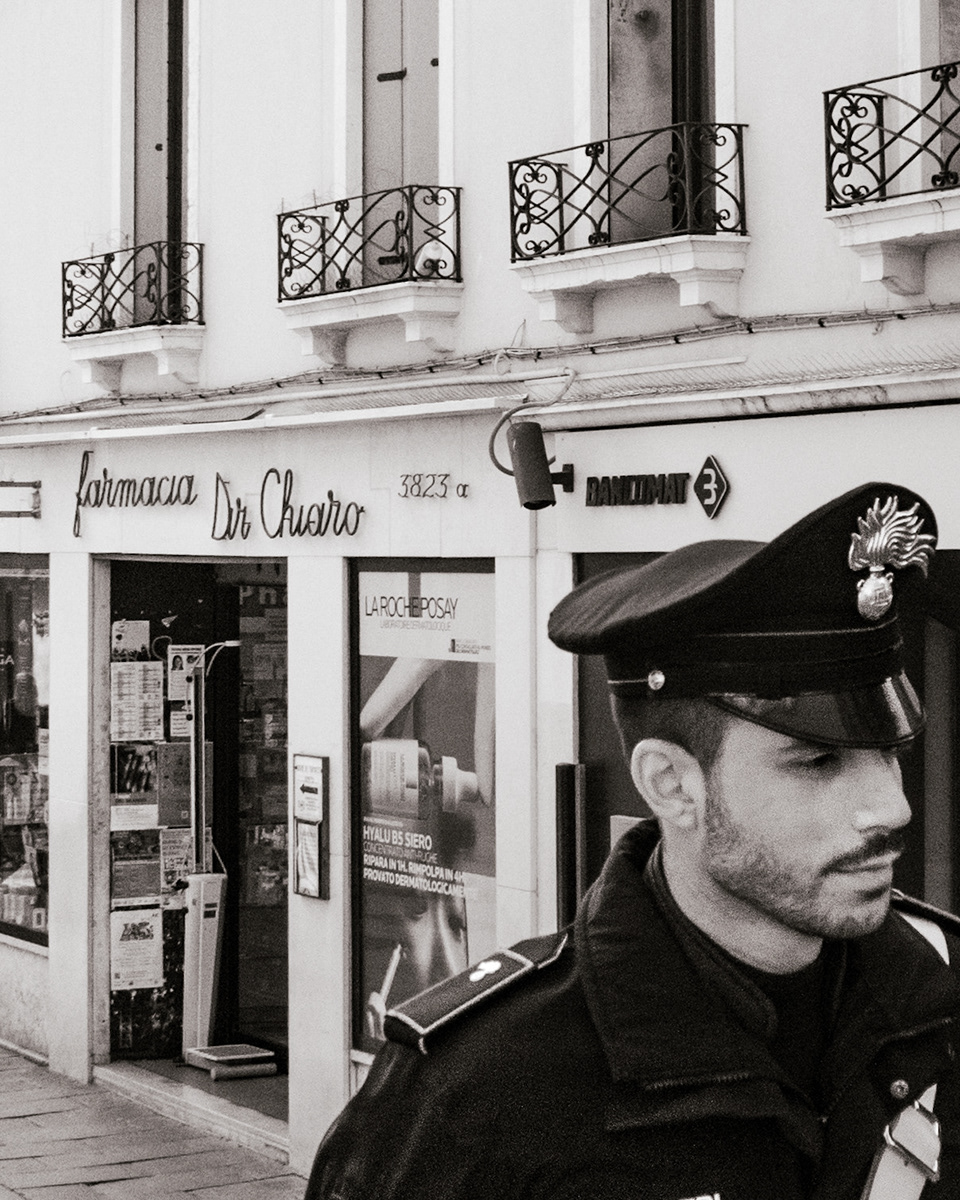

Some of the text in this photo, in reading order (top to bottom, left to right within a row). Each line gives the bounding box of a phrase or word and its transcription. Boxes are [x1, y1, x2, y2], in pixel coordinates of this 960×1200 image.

[72, 450, 198, 538] farmacia
[211, 471, 251, 541] Dr
[397, 473, 451, 499] 3823
[365, 595, 458, 619] LA ROCHE POSAY
[363, 825, 433, 851] HYALU B5 SIERO
